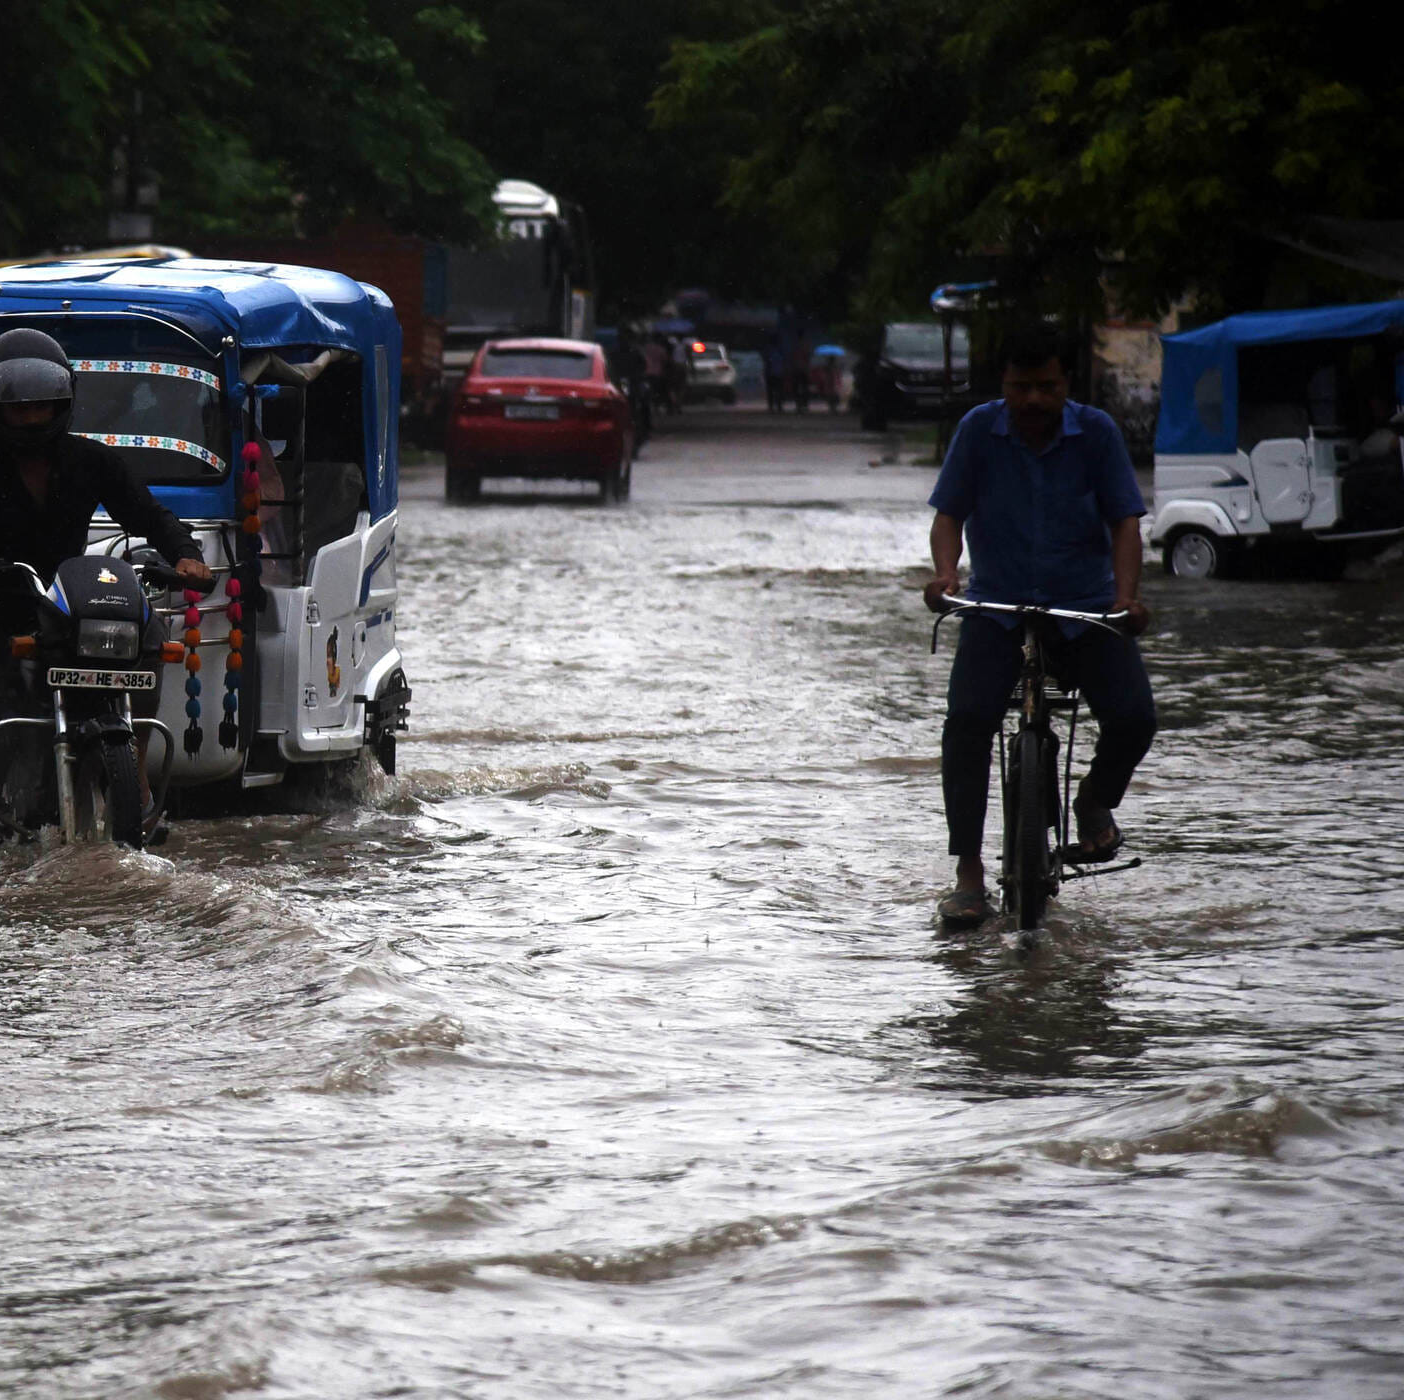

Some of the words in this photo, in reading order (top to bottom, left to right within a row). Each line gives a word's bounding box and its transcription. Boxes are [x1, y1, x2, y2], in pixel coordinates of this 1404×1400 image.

[50, 671, 80, 685] UP32
[96, 673, 113, 686] HE
[124, 674, 153, 688] 3854
